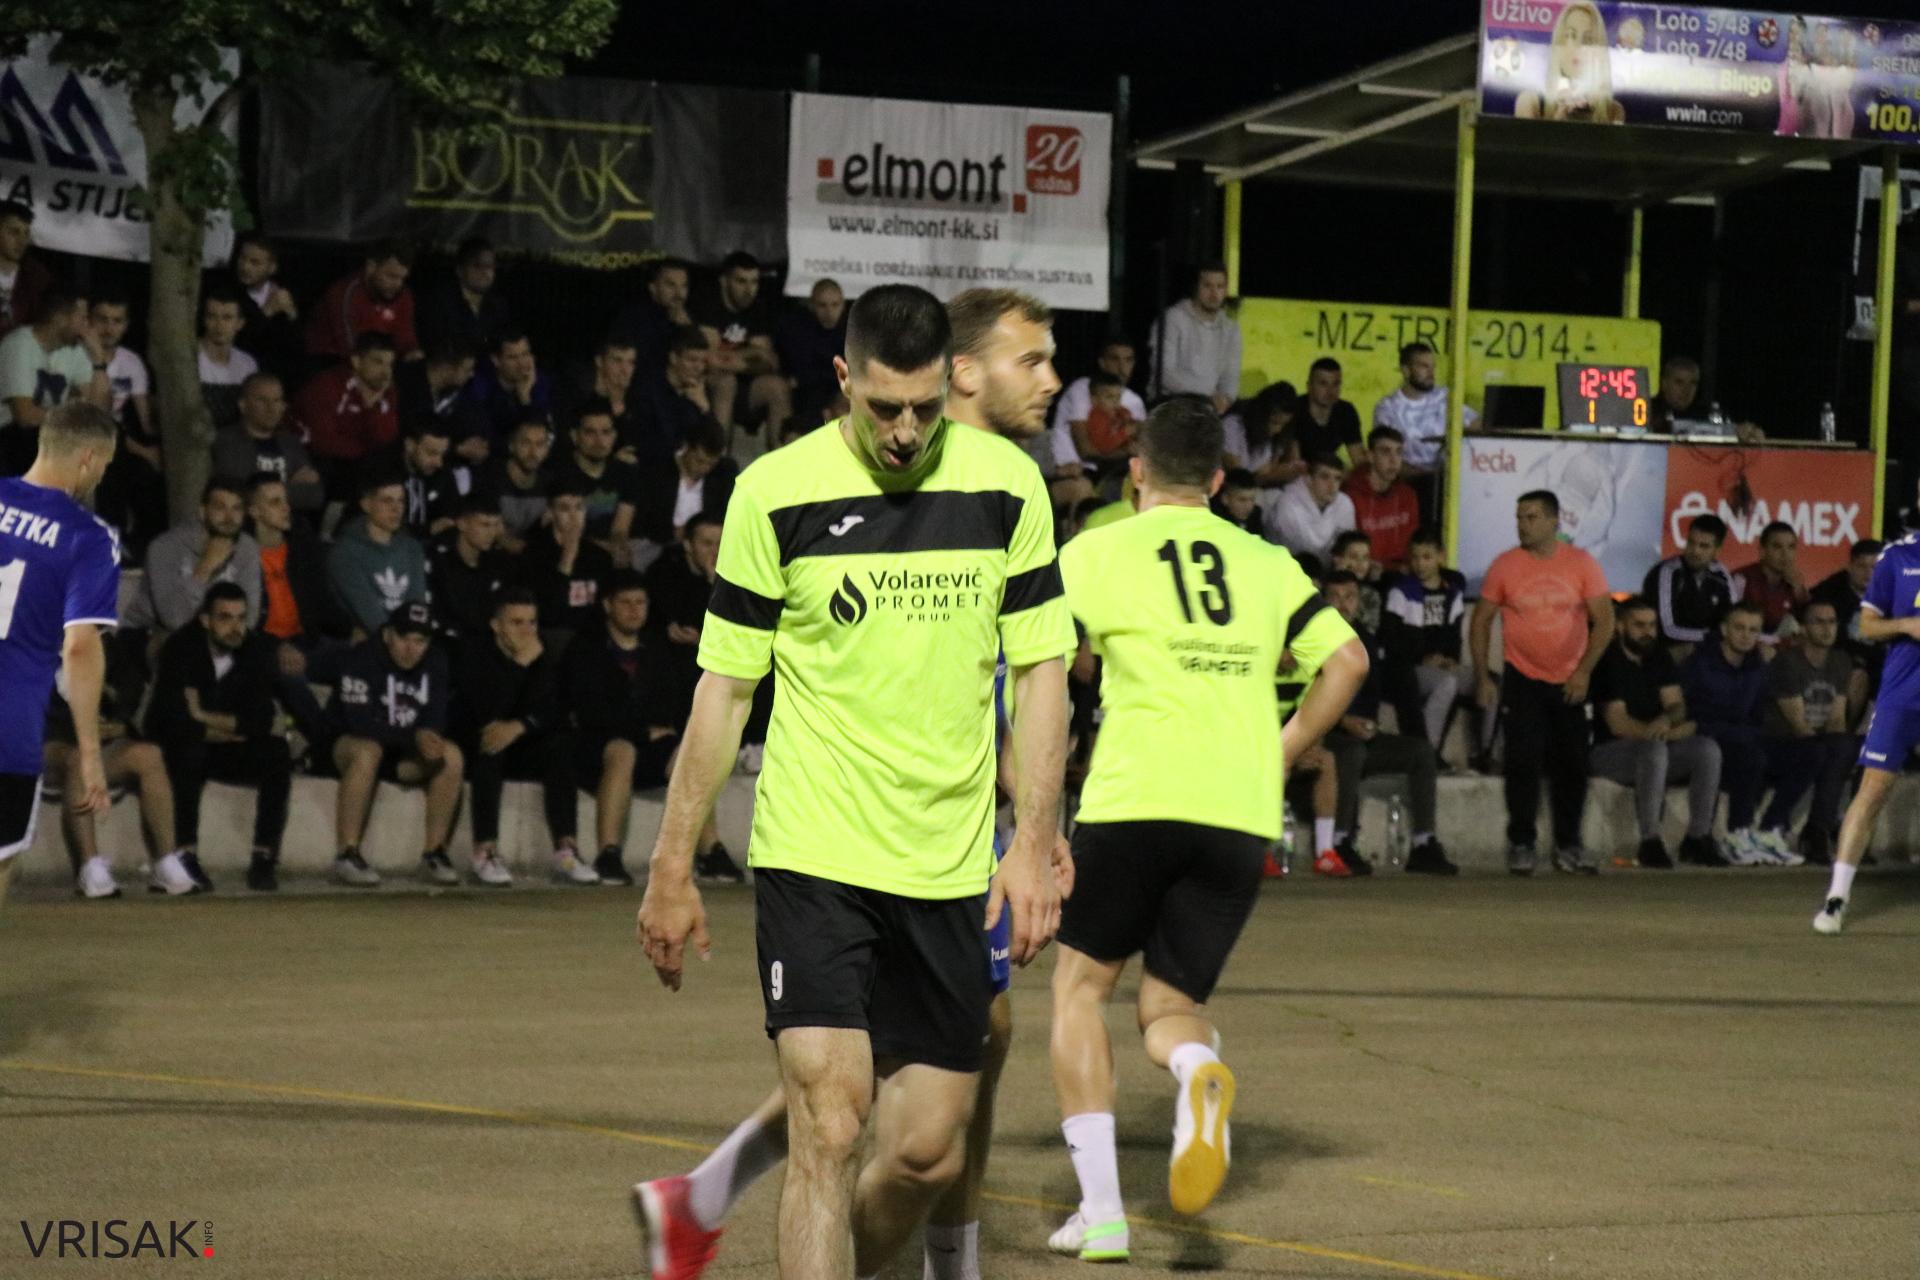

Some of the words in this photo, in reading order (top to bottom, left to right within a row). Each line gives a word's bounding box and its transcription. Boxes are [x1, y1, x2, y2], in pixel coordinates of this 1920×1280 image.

[1491, 0, 1552, 25] Uživo
[1654, 9, 1700, 32] Loto
[1705, 14, 1750, 36] 5/48
[1705, 38, 1747, 62] 7/48
[1720, 67, 1773, 97] Bingo
[1666, 104, 1743, 126] wwin.com
[1865, 101, 1920, 134] 100.
[1025, 132, 1085, 173] 20
[412, 124, 645, 224] BORAK
[842, 143, 1006, 204] elmont
[47, 179, 154, 223] STIJE
[828, 214, 999, 241] www.elmont-kk.si
[1579, 368, 1638, 400] 12:45
[1588, 399, 1596, 424] 1
[1633, 398, 1648, 427] 0
[0, 502, 61, 549] ETKA
[1718, 499, 1860, 547] NAMEX
[868, 567, 983, 591] Volarević
[1155, 538, 1233, 627] 13
[875, 592, 982, 611] PROMET
[906, 613, 951, 623] PRUD
[770, 960, 784, 1001] 9
